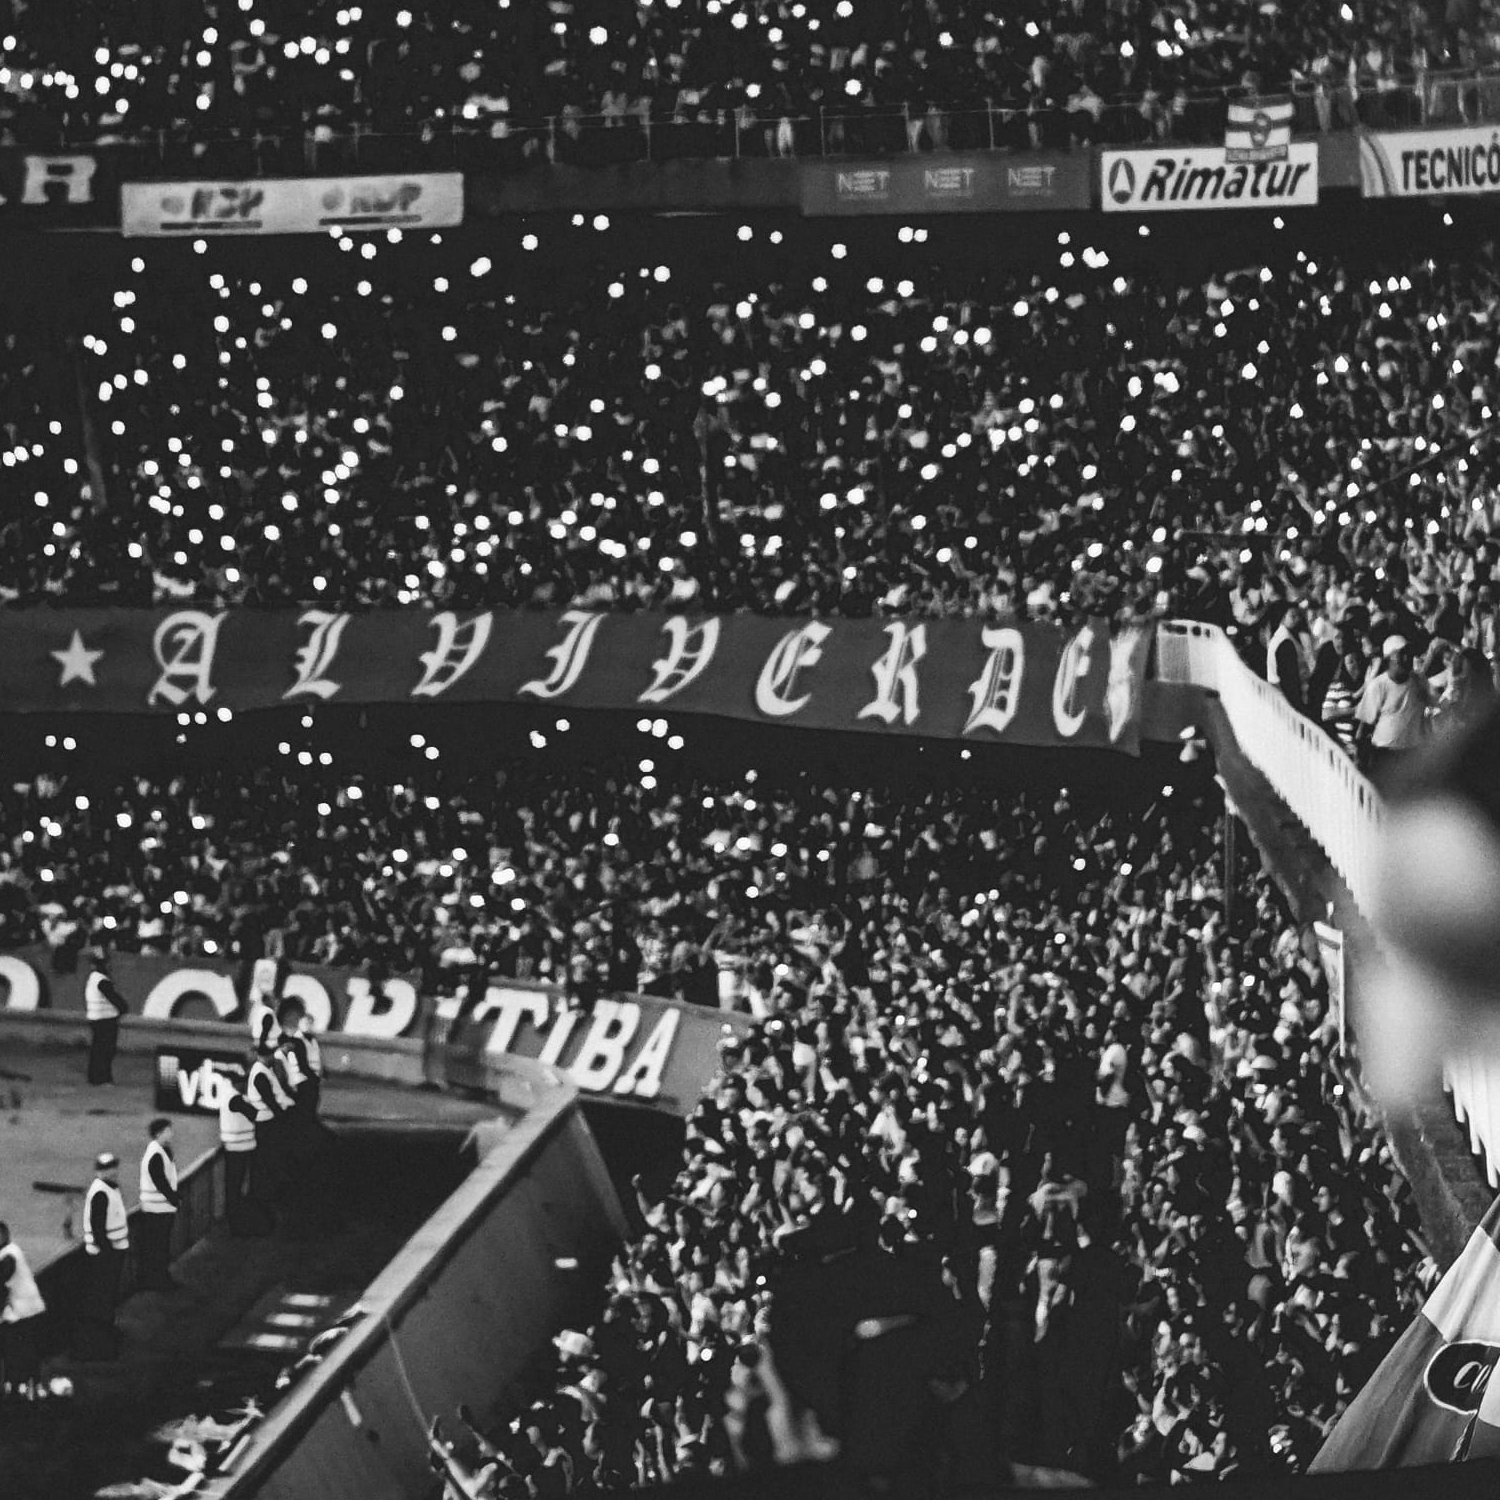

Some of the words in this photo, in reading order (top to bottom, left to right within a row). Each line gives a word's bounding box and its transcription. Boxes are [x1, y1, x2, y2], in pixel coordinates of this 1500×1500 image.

[836, 171, 891, 192] NET
[923, 168, 975, 190] NET
[1008, 165, 1056, 188] NET
[1140, 157, 1312, 202] Rimatur
